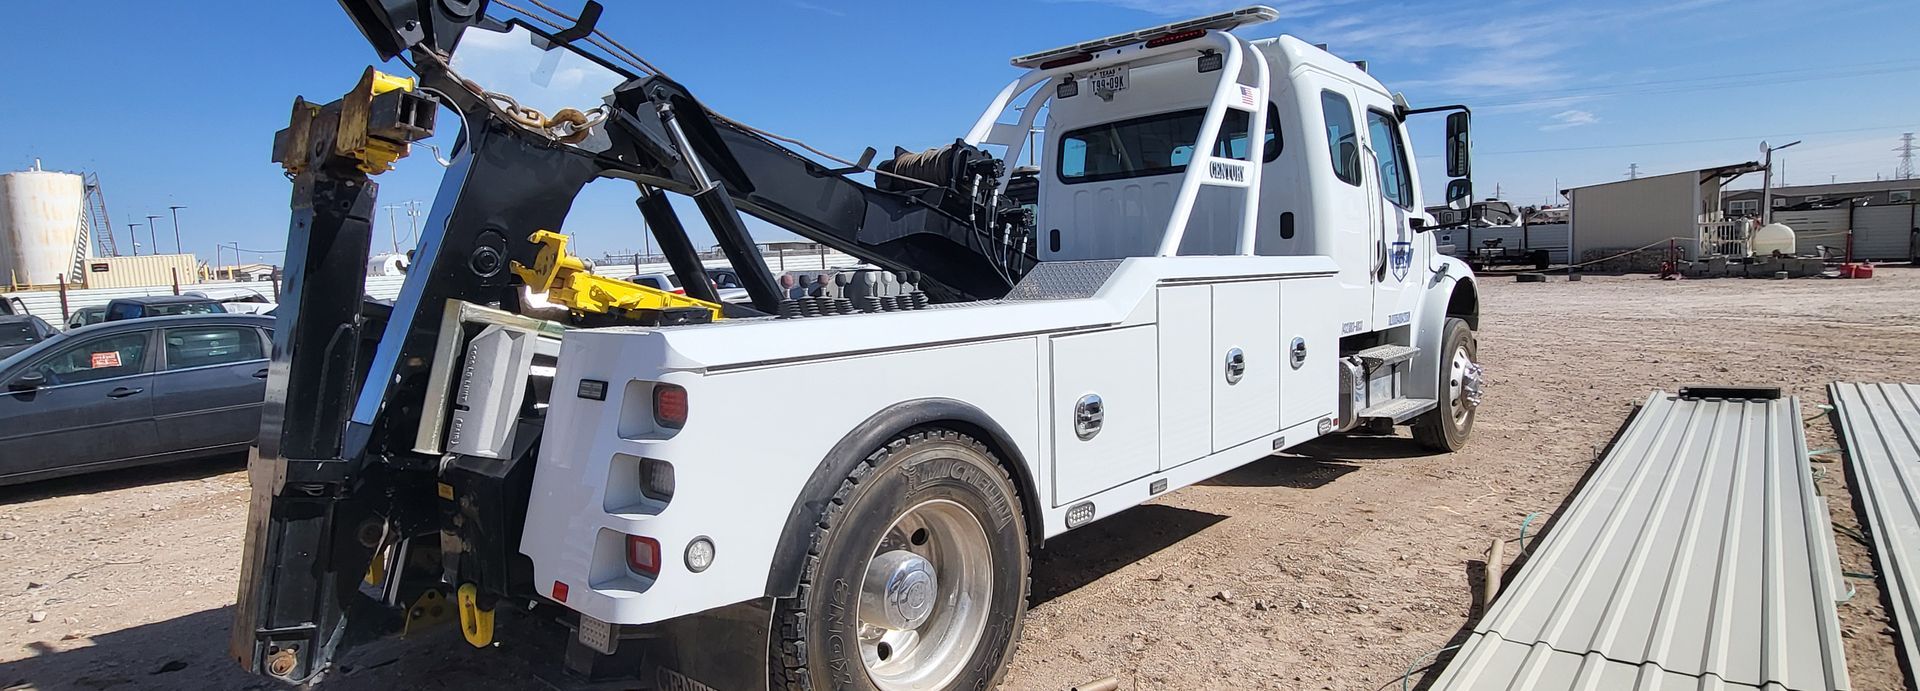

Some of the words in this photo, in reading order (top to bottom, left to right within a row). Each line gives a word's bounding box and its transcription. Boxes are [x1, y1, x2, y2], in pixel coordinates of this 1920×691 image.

[1099, 69, 1116, 78] TEXAS
[1209, 160, 1245, 182] CENTURY
[920, 460, 1014, 533] MICHELIN
